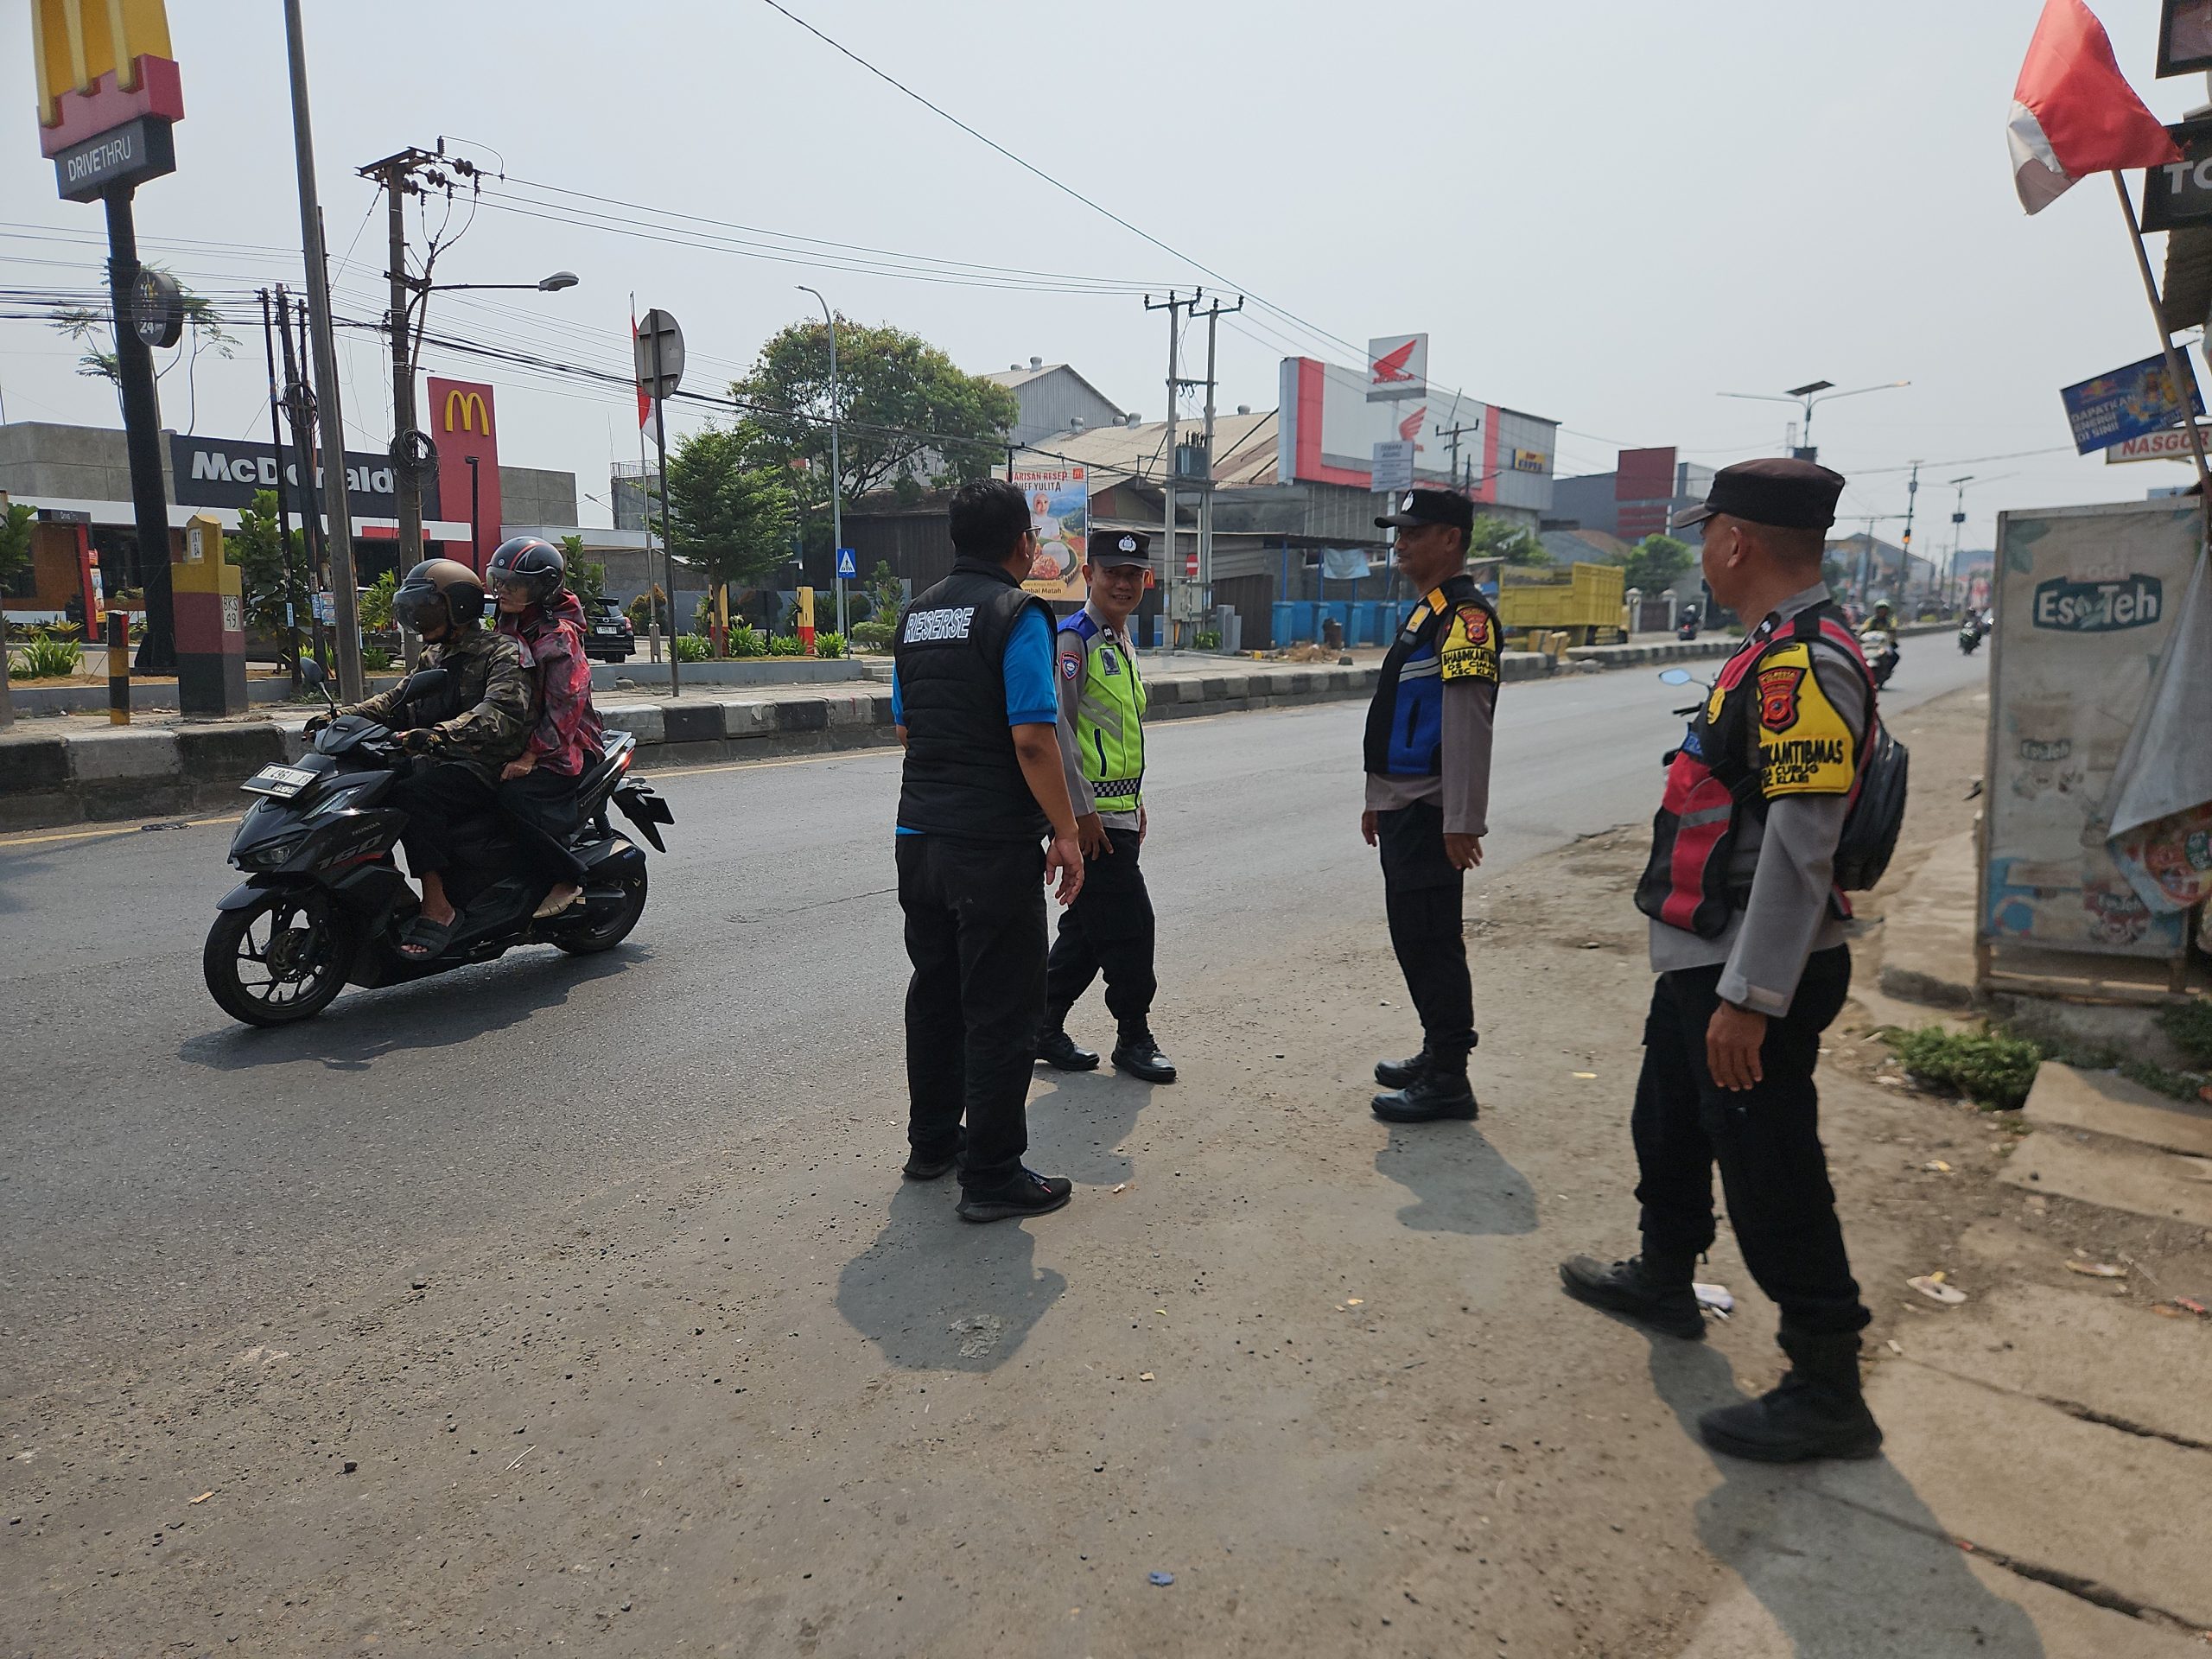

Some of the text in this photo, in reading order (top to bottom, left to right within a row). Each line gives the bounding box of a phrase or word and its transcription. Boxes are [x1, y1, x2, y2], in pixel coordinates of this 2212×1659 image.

[67, 136, 131, 182] DRIVETHRU
[1034, 481, 1062, 492] YULITA
[223, 597, 238, 612] BKS
[2038, 583, 2157, 625] Es Teh
[226, 613, 237, 628] 49
[903, 607, 975, 644] RESERSE
[352, 822, 380, 836] HONDA
